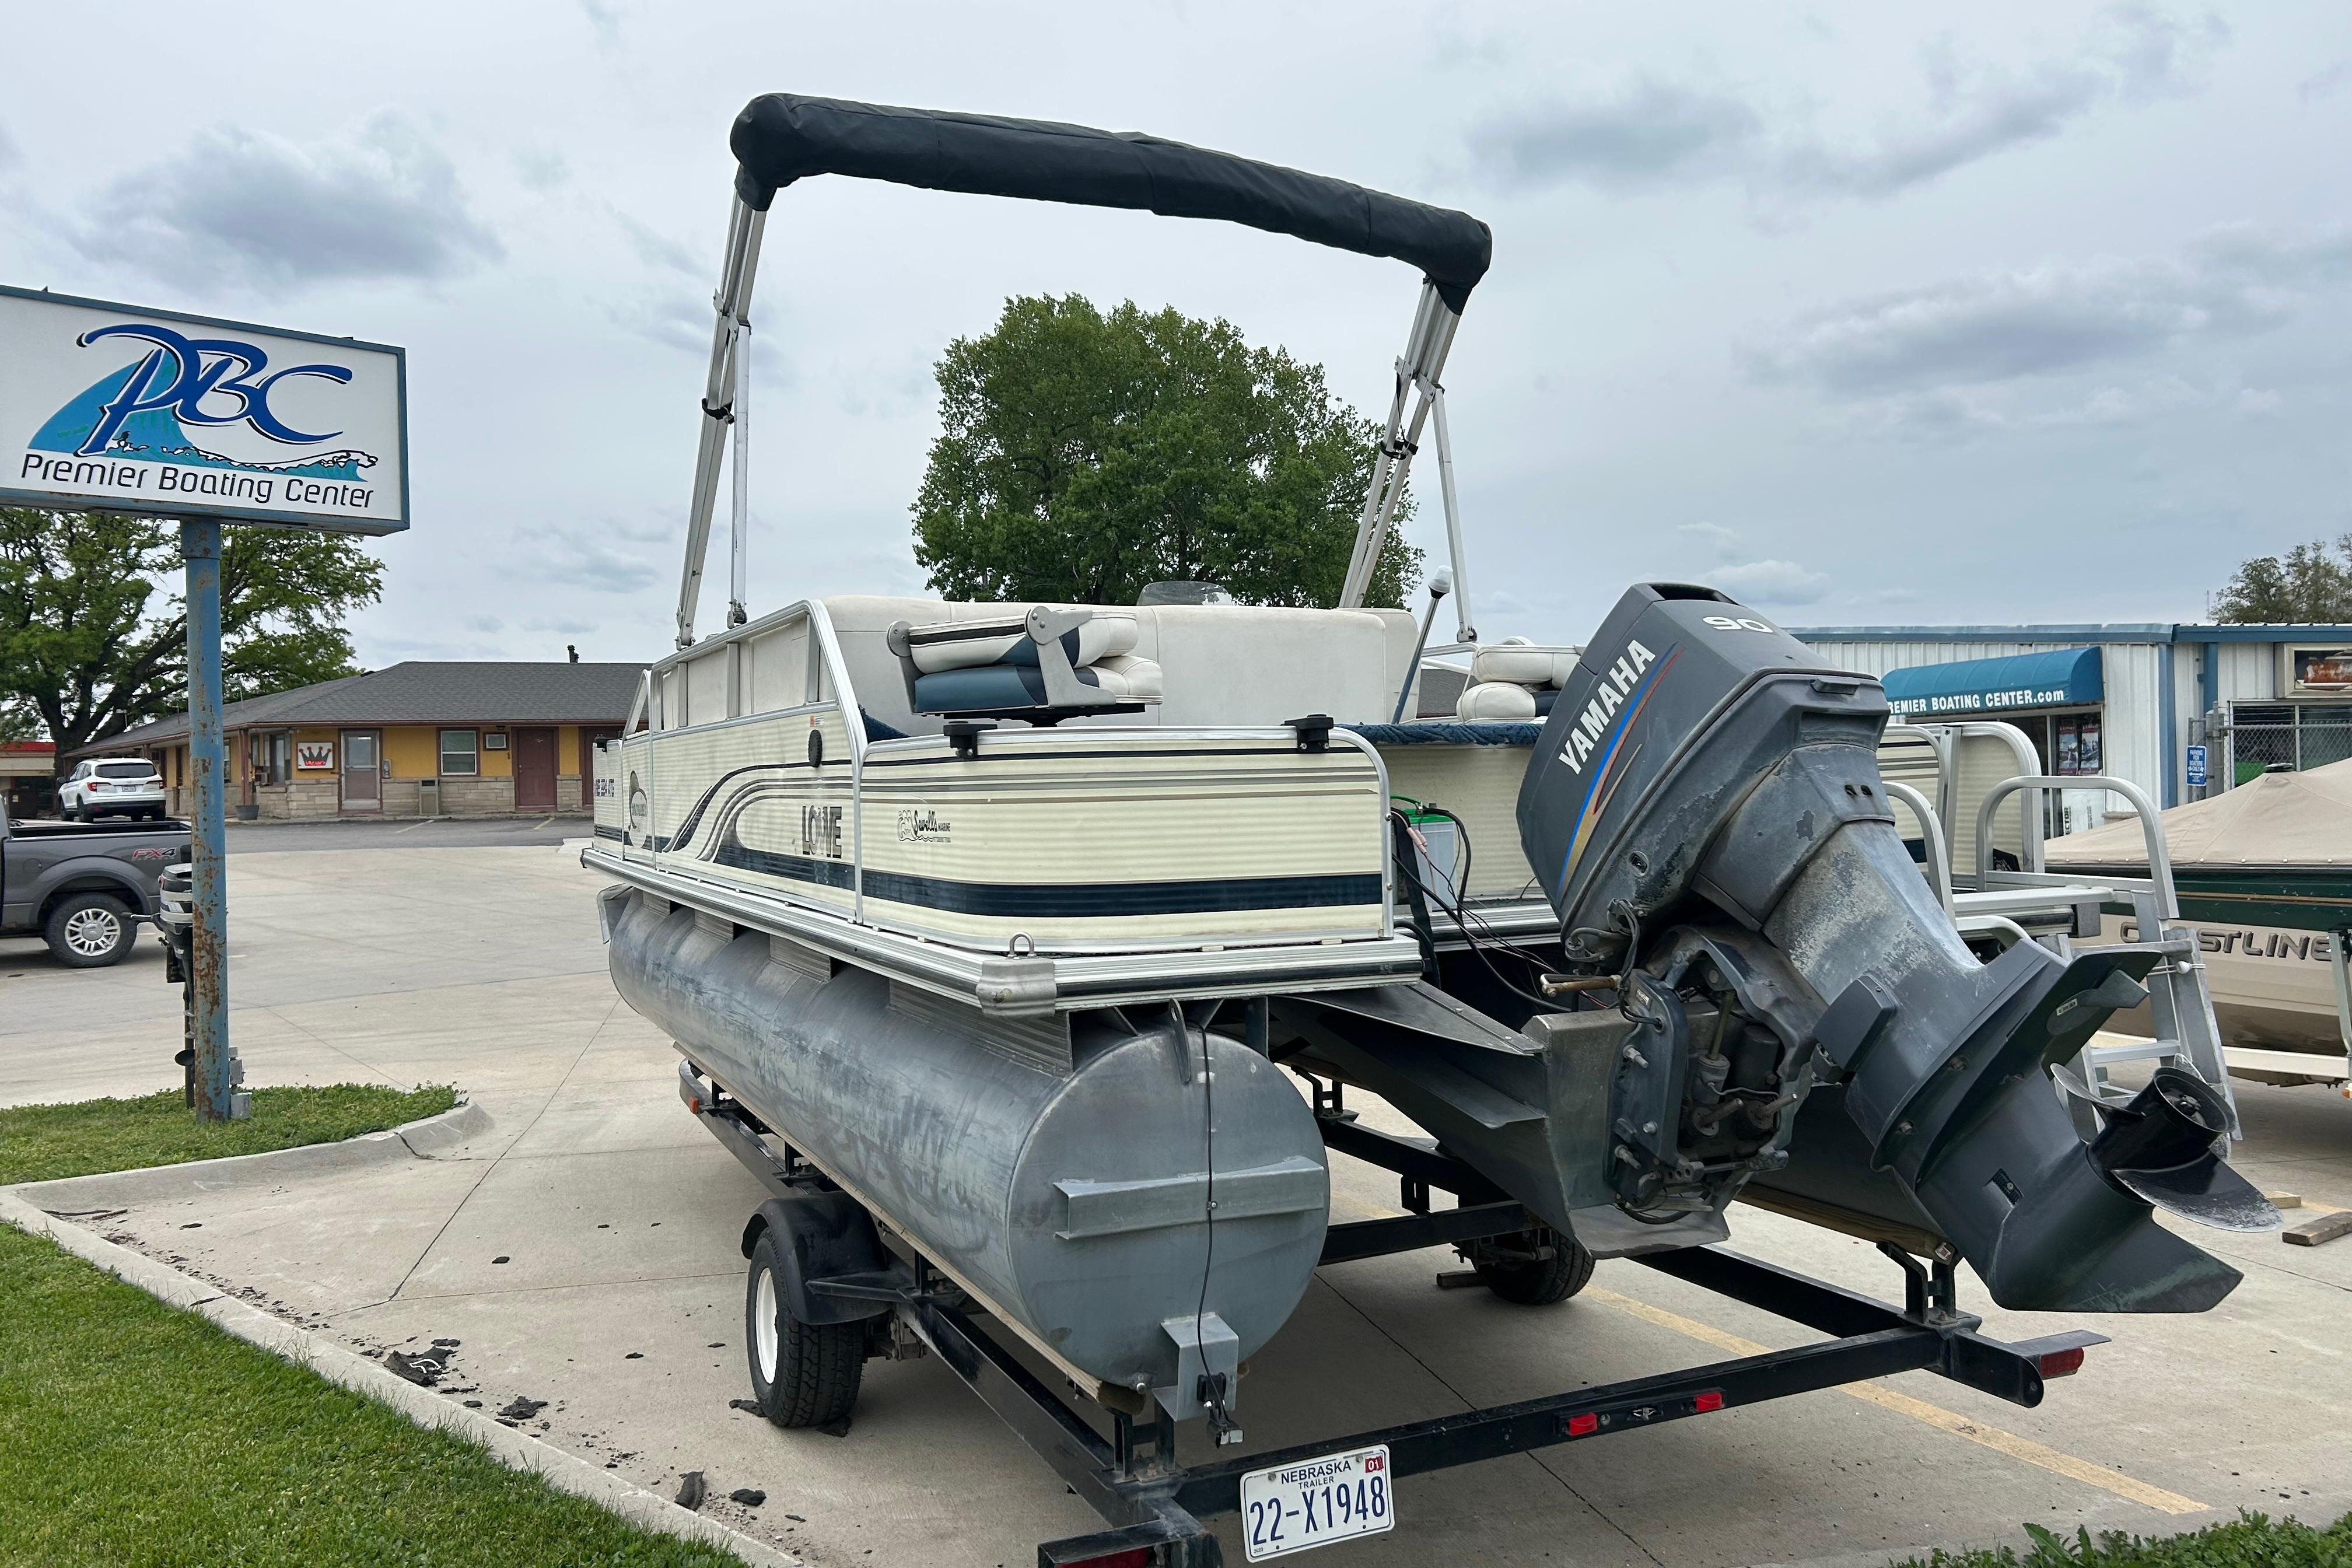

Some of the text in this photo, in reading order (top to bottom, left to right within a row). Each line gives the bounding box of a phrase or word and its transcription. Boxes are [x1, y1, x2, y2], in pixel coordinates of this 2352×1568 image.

[76, 324, 352, 457] PBC
[22, 453, 374, 508] Premier Boating Center
[1702, 616, 1773, 634] 90
[1558, 639, 1656, 775] YAMAHA
[1888, 689, 2064, 714] REMIER BOATING CENTER.com
[132, 848, 177, 859] FX4
[2120, 921, 2332, 962] CSTLINE
[1281, 1460, 1352, 1485] NEBRASKA
[1298, 1476, 1335, 1490] TRAILER
[1250, 1476, 1385, 1545] 22-X1948
